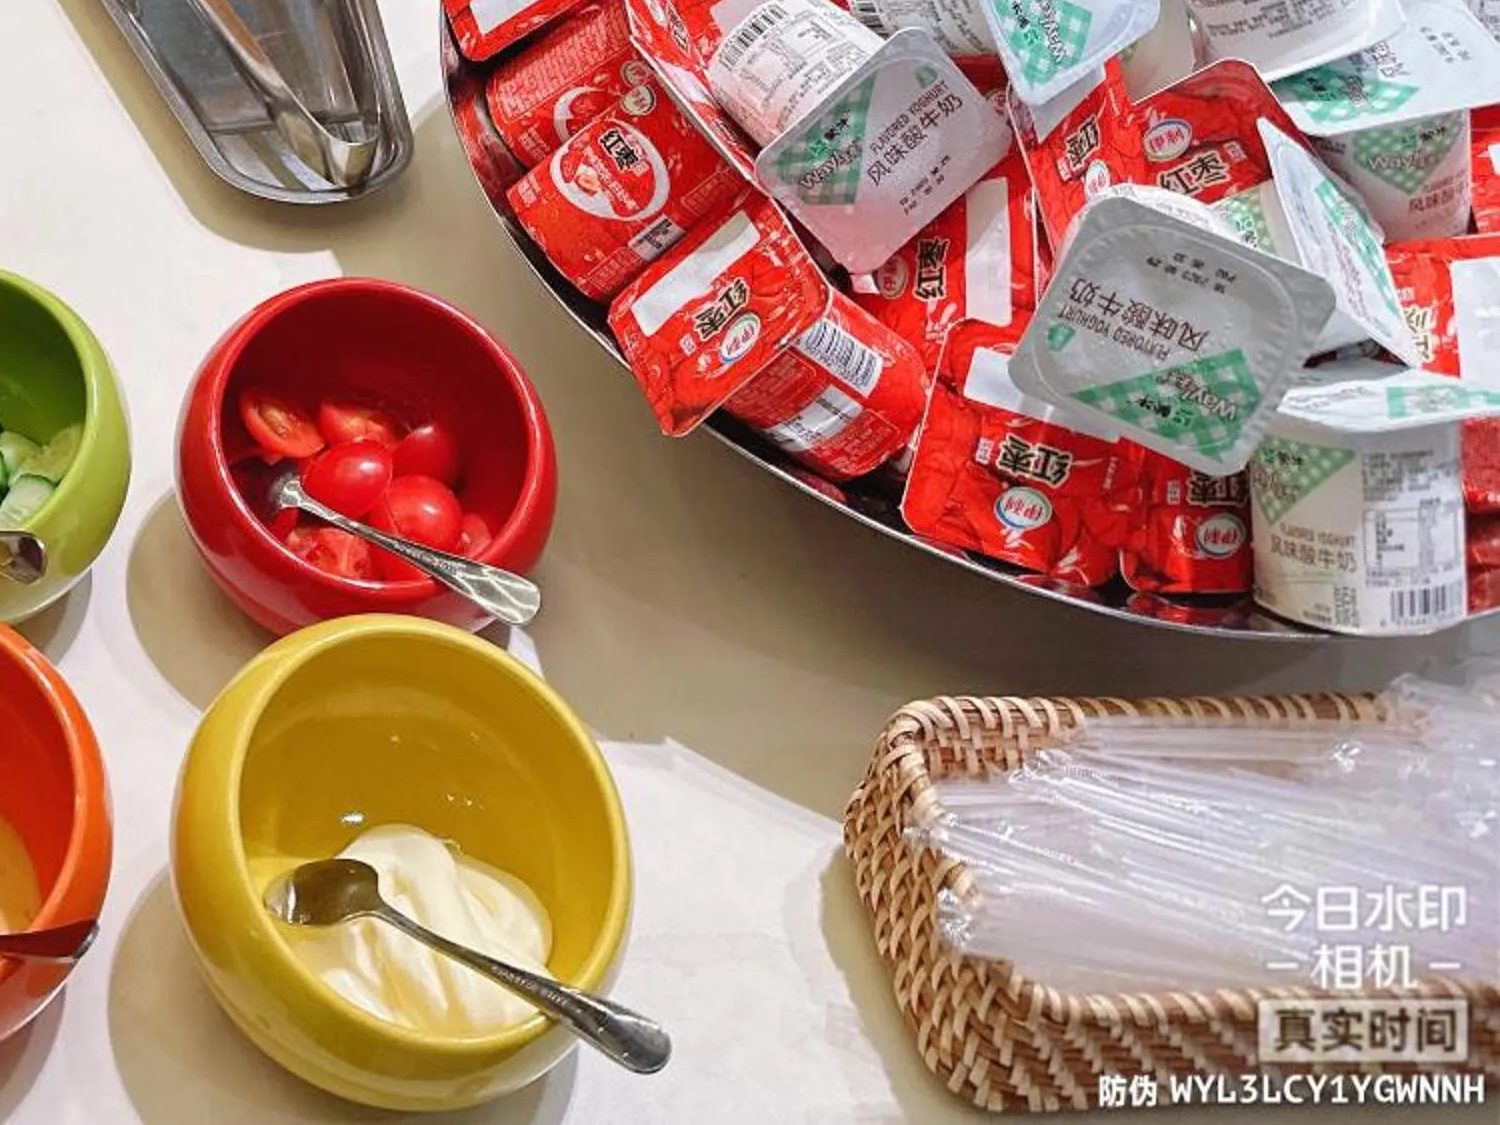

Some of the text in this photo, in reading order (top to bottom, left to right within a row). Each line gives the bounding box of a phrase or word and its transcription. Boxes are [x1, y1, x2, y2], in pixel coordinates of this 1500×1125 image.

[867, 93, 964, 187] 风味酸牛奶
[1159, 151, 1229, 195] 红枣
[914, 239, 948, 299] 红枣
[695, 278, 747, 340] 红枣
[1068, 277, 1211, 353] 风味酸牛奶
[998, 434, 1072, 487] 红枣
